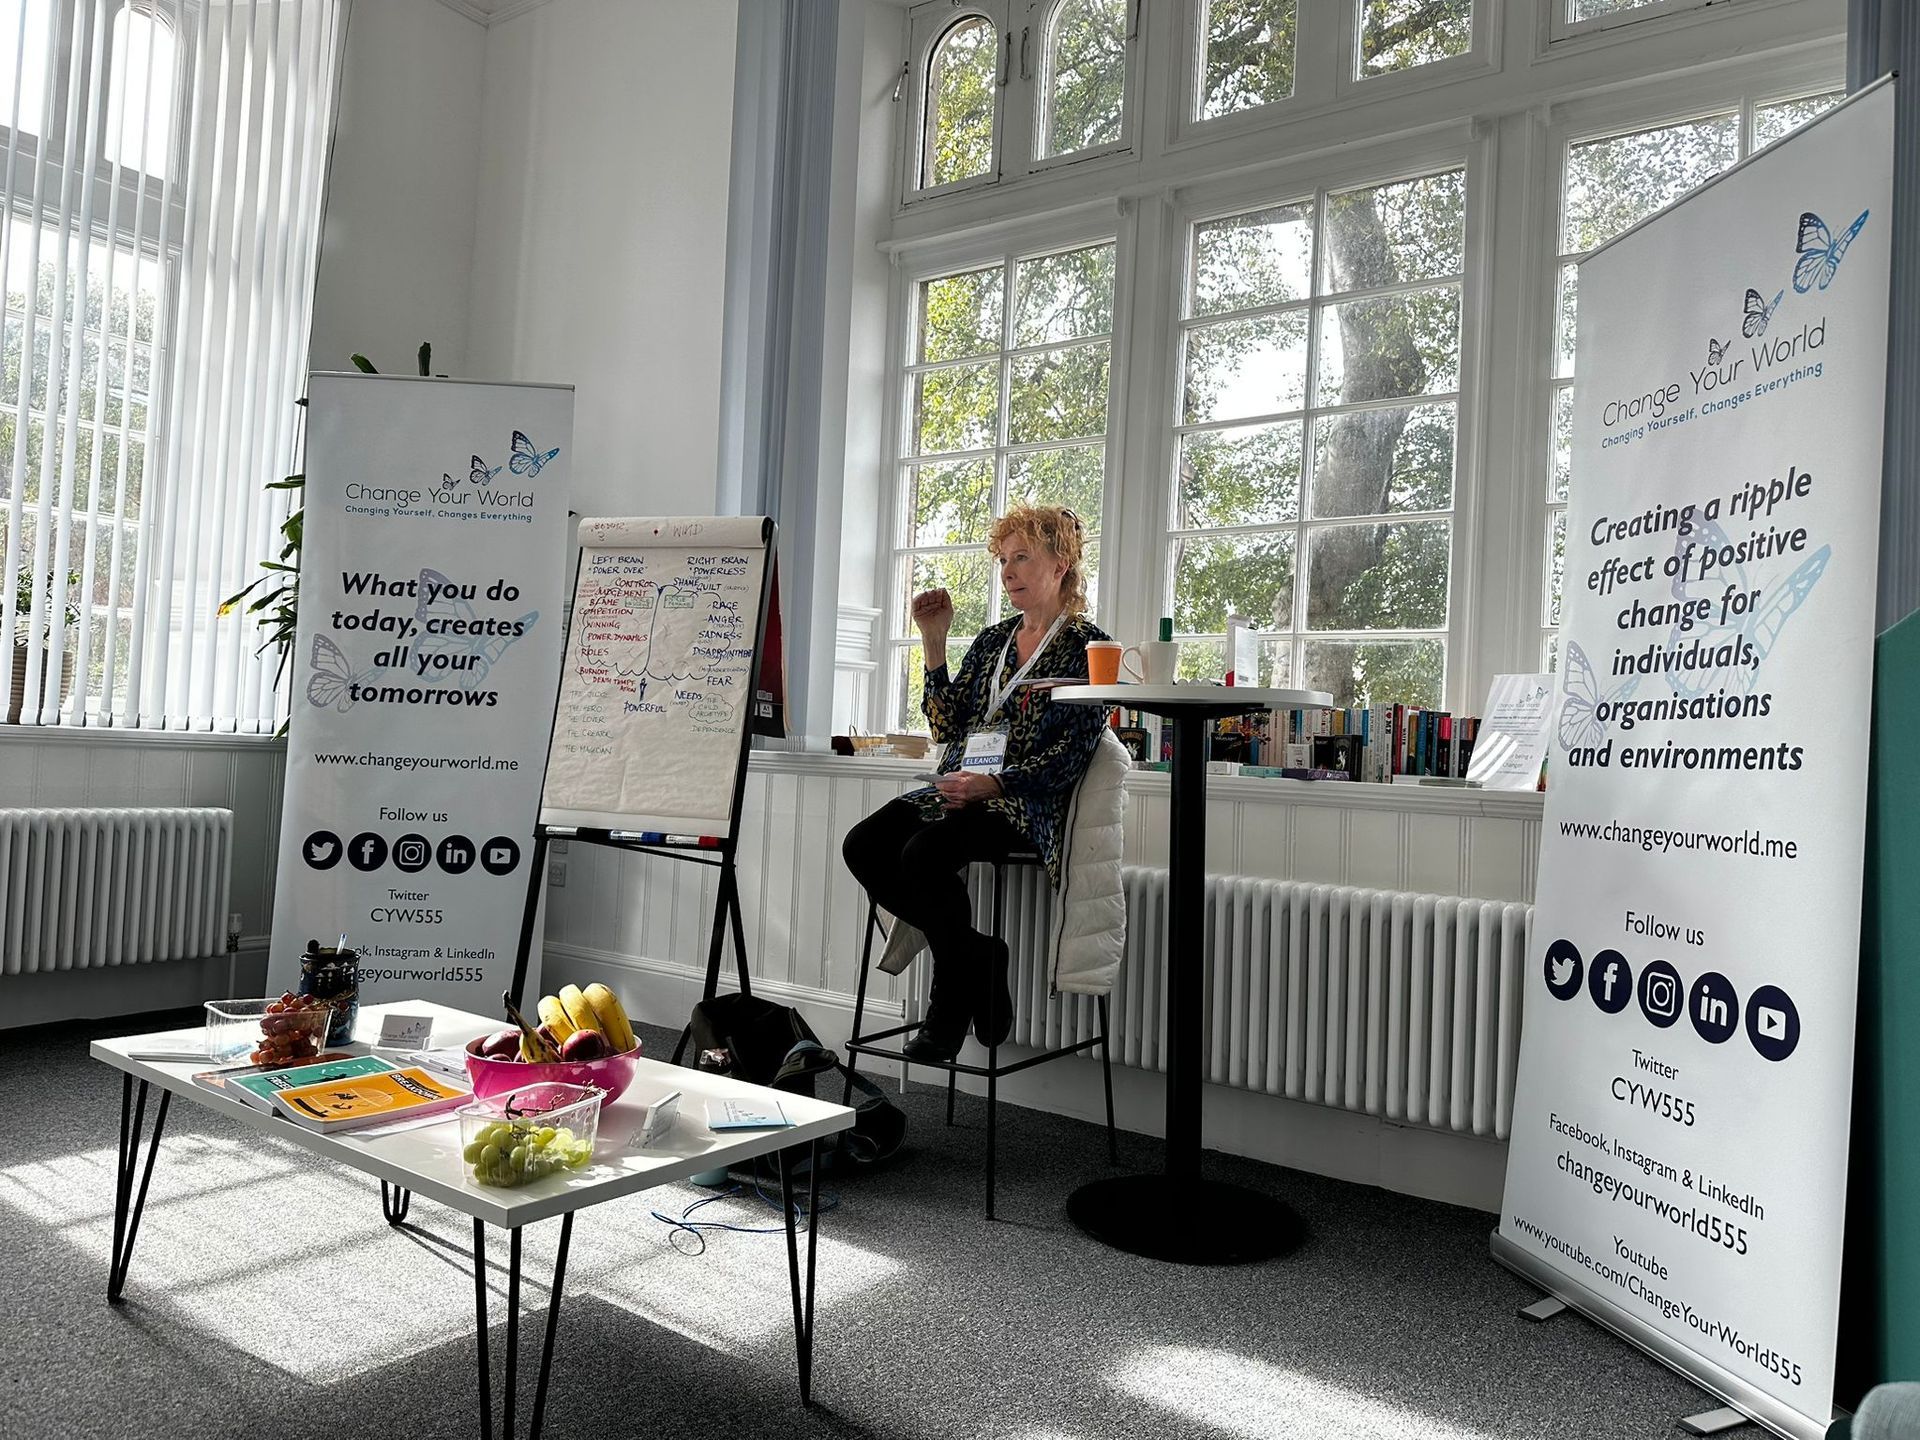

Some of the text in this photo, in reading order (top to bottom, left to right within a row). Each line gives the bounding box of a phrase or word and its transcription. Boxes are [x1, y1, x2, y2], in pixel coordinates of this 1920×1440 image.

[1603, 316, 1827, 427] Change Your World
[1601, 424, 1644, 449] Changing
[1701, 391, 1751, 416] Changes
[1755, 362, 1823, 397] Everything
[345, 484, 534, 508] Change Your World
[1590, 466, 1812, 546] Creating a ripple
[345, 505, 390, 517] Changing
[437, 510, 478, 520] Changes
[481, 512, 532, 523] Everything
[592, 556, 644, 564] LEFT BRAIN
[687, 556, 749, 565] RIGHT BRAIN
[1587, 526, 1807, 596] effect of positive
[342, 572, 520, 604] What you do
[673, 577, 699, 587] SHAME
[707, 614, 743, 624] ANGER
[1617, 584, 1761, 632] change for
[331, 609, 524, 638] today, creates
[698, 630, 742, 640] SADNESS
[374, 646, 481, 675] all your
[1612, 634, 1760, 675] individuals,
[349, 682, 498, 706] tomorrows
[674, 689, 703, 700] NEEDS
[706, 676, 733, 687] FEAR
[623, 701, 667, 714] POWERFUL
[1595, 688, 1771, 730] organisations
[314, 752, 519, 772] www.changeyourworld.me
[965, 756, 999, 765] ELEANOR
[1568, 739, 1804, 771] and environments
[380, 807, 448, 822] Follow us
[1560, 819, 1798, 859] www.changeyourworld.me
[388, 889, 429, 901] Twitter
[370, 908, 443, 924] CYW555
[1625, 911, 1704, 946] Follow us
[375, 945, 430, 961] Instagram
[433, 947, 443, 958] &
[447, 947, 495, 960] LinkedIn
[357, 966, 483, 983] geyourworld555
[1632, 1049, 1679, 1081] Twitter
[1611, 1076, 1696, 1127] CYW555
[1549, 1112, 1764, 1221] Facebook, Instagram & LinkedIn
[1557, 1150, 1748, 1256] changeyourworld555
[1613, 1235, 1668, 1280] Youtube
[1513, 1215, 1802, 1387] www.youtube.com/ChangeYourWorld555
